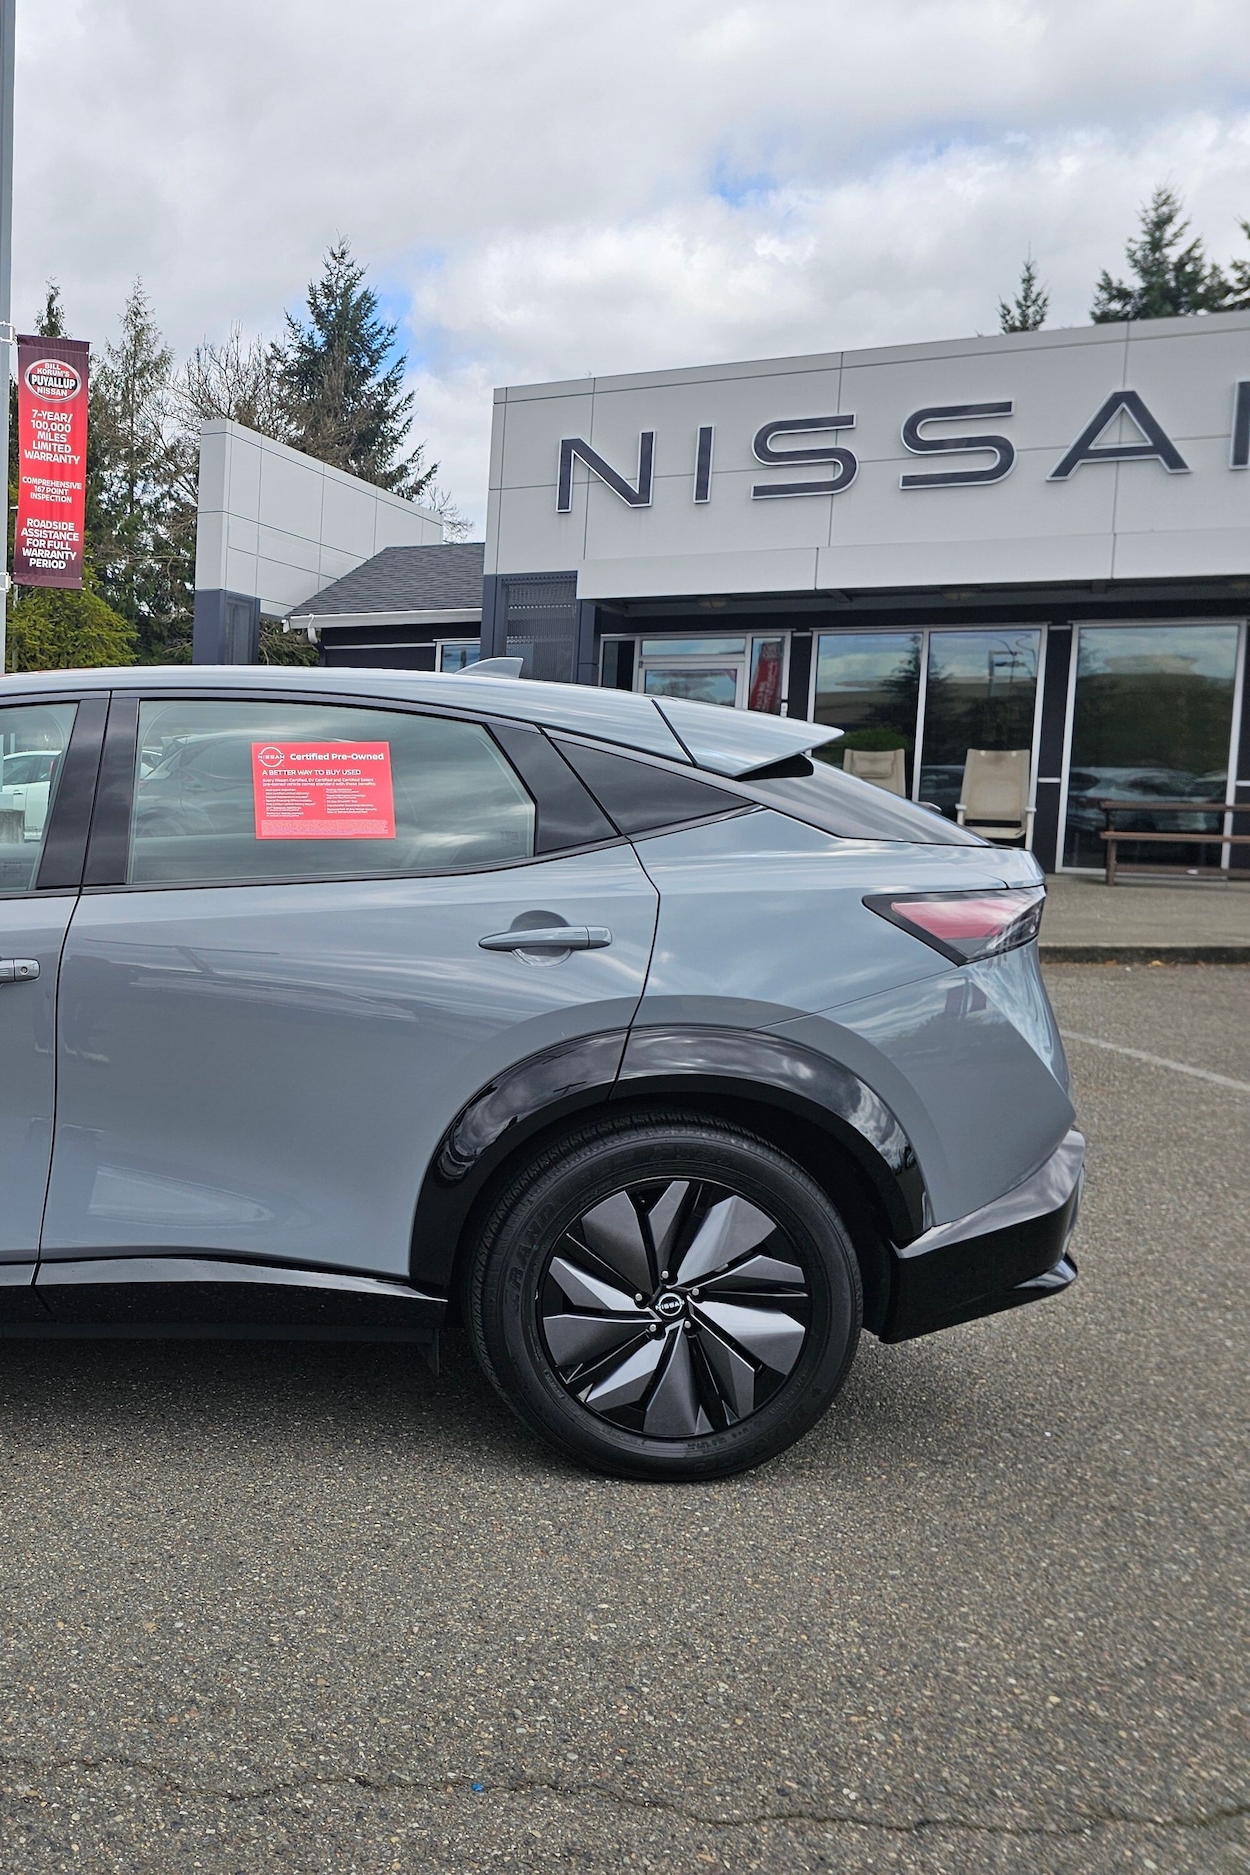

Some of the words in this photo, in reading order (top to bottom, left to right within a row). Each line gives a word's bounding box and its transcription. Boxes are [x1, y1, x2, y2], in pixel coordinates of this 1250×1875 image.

[37, 368, 70, 377] KORUM'S
[31, 374, 76, 389] PUYALLUP
[37, 387, 68, 396] NISSAN
[31, 409, 73, 424] 7-YEAR/
[30, 419, 72, 433] 100,000
[37, 430, 67, 443] MILES
[32, 440, 72, 453] LIMITED
[556, 380, 1250, 512] NISSA
[24, 449, 81, 465] WARRANTY
[22, 476, 82, 490] COMPREHENSIVE
[30, 492, 72, 503] INSPECTION
[46, 487, 69, 496] POINT
[26, 518, 75, 531] ROADSIDE
[20, 527, 80, 542] ASSISTANCE
[26, 538, 46, 549] FOR
[47, 540, 72, 550] FULL
[22, 547, 77, 561] WARRANTY
[29, 558, 66, 569] PERIOD
[290, 753, 330, 761] Certified
[331, 753, 384, 761] Pre-Owned
